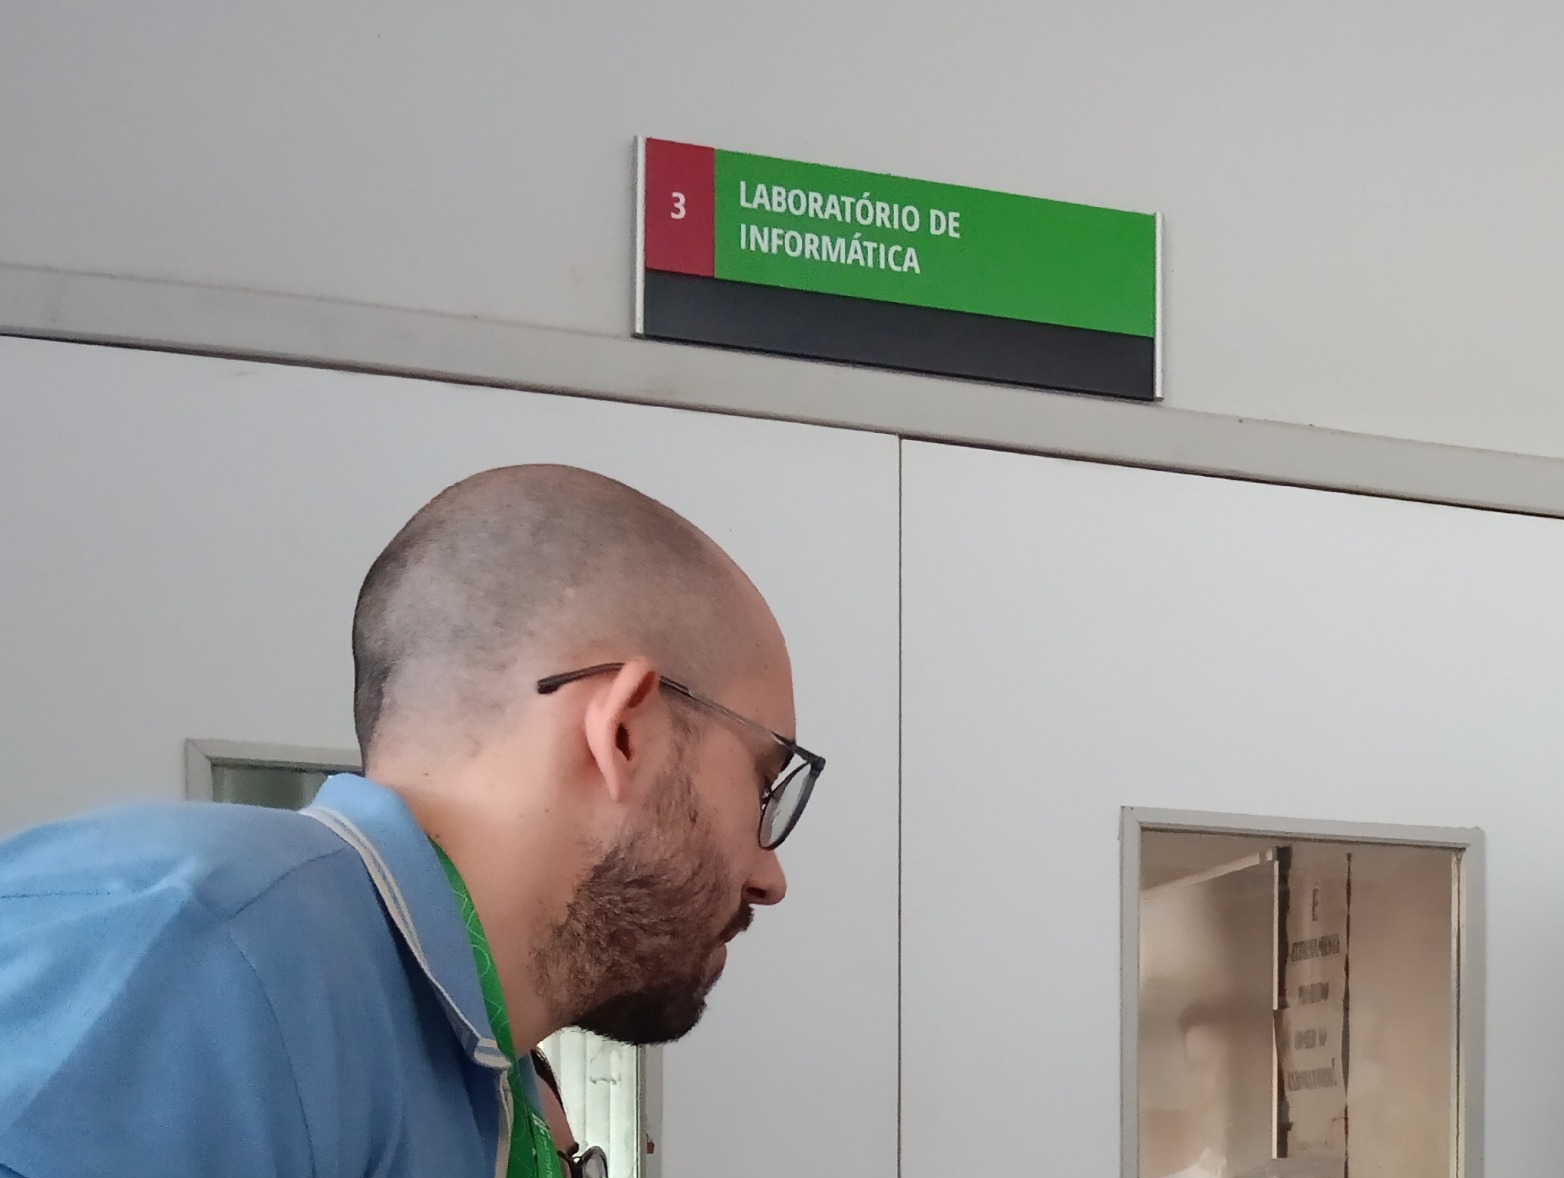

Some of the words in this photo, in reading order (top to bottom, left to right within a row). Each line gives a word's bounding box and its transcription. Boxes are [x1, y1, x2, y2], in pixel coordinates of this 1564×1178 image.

[670, 192, 687, 219] 3
[739, 181, 921, 233] LABORATÓRIO
[929, 208, 961, 239] DE
[739, 223, 921, 275] INFORMÁTICA
